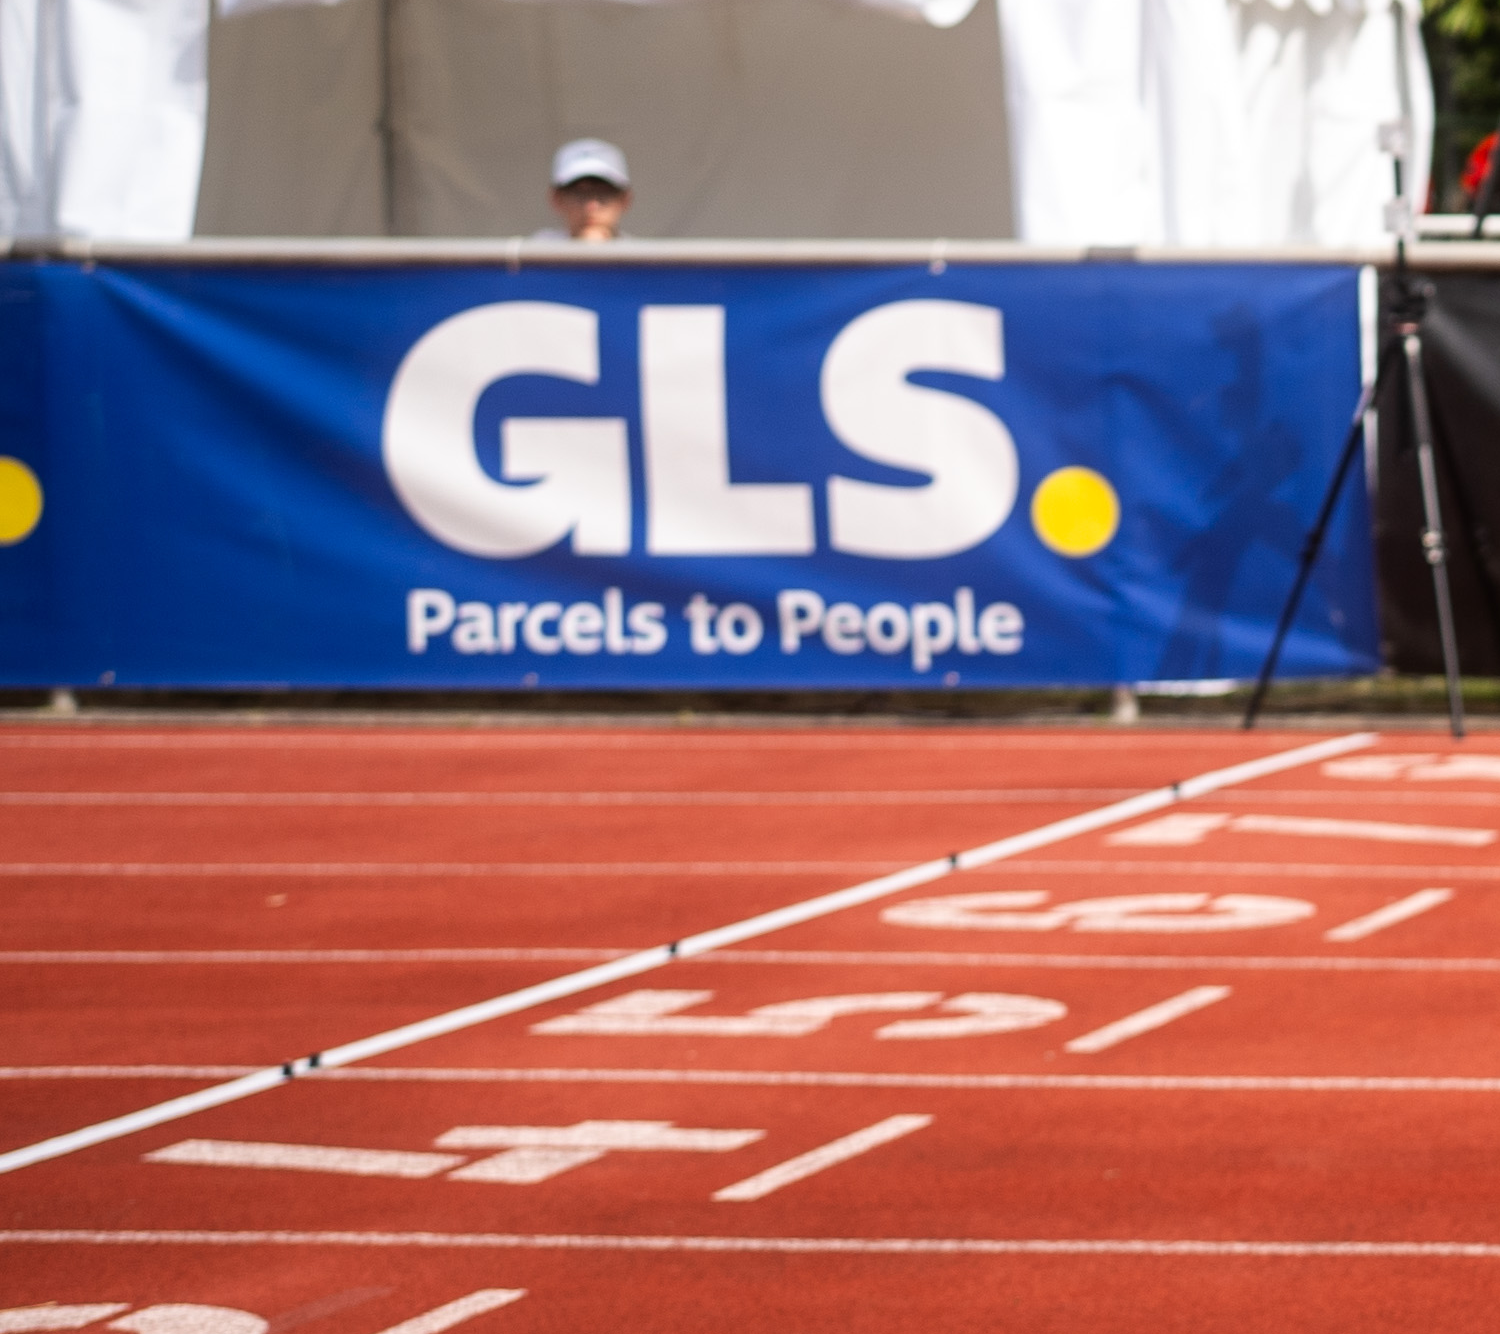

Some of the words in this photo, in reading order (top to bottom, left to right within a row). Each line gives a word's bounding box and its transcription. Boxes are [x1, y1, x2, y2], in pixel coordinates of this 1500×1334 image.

[406, 587, 669, 655] Parcels
[683, 592, 765, 655] to
[777, 587, 1025, 672] People
[528, 988, 1068, 1040] 5
[143, 1120, 767, 1183] 4
